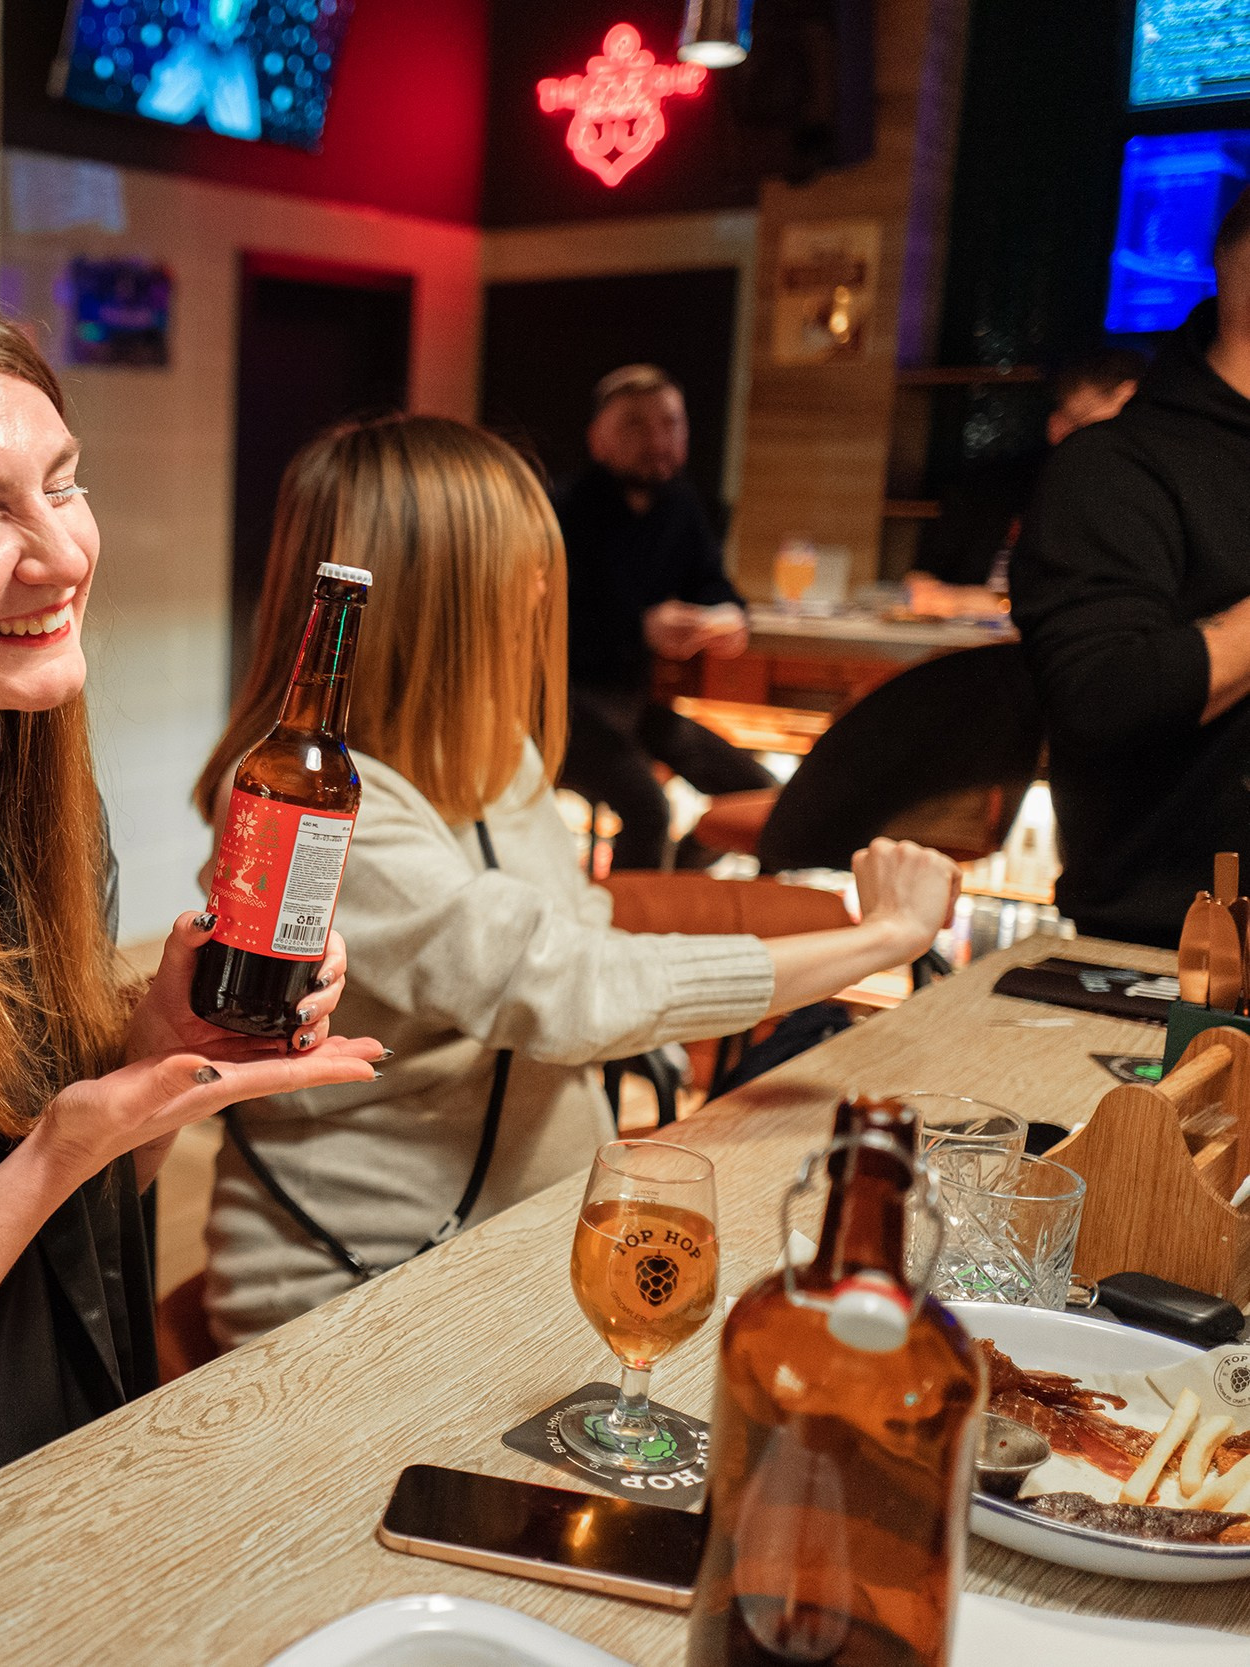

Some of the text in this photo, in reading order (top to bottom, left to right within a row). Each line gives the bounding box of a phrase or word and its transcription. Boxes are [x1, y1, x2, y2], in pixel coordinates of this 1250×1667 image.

[613, 1230, 702, 1259] TOP HOP
[1224, 1356, 1248, 1366] TOP
[546, 1435, 567, 1455] PUB
[619, 1468, 705, 1491] HOP
